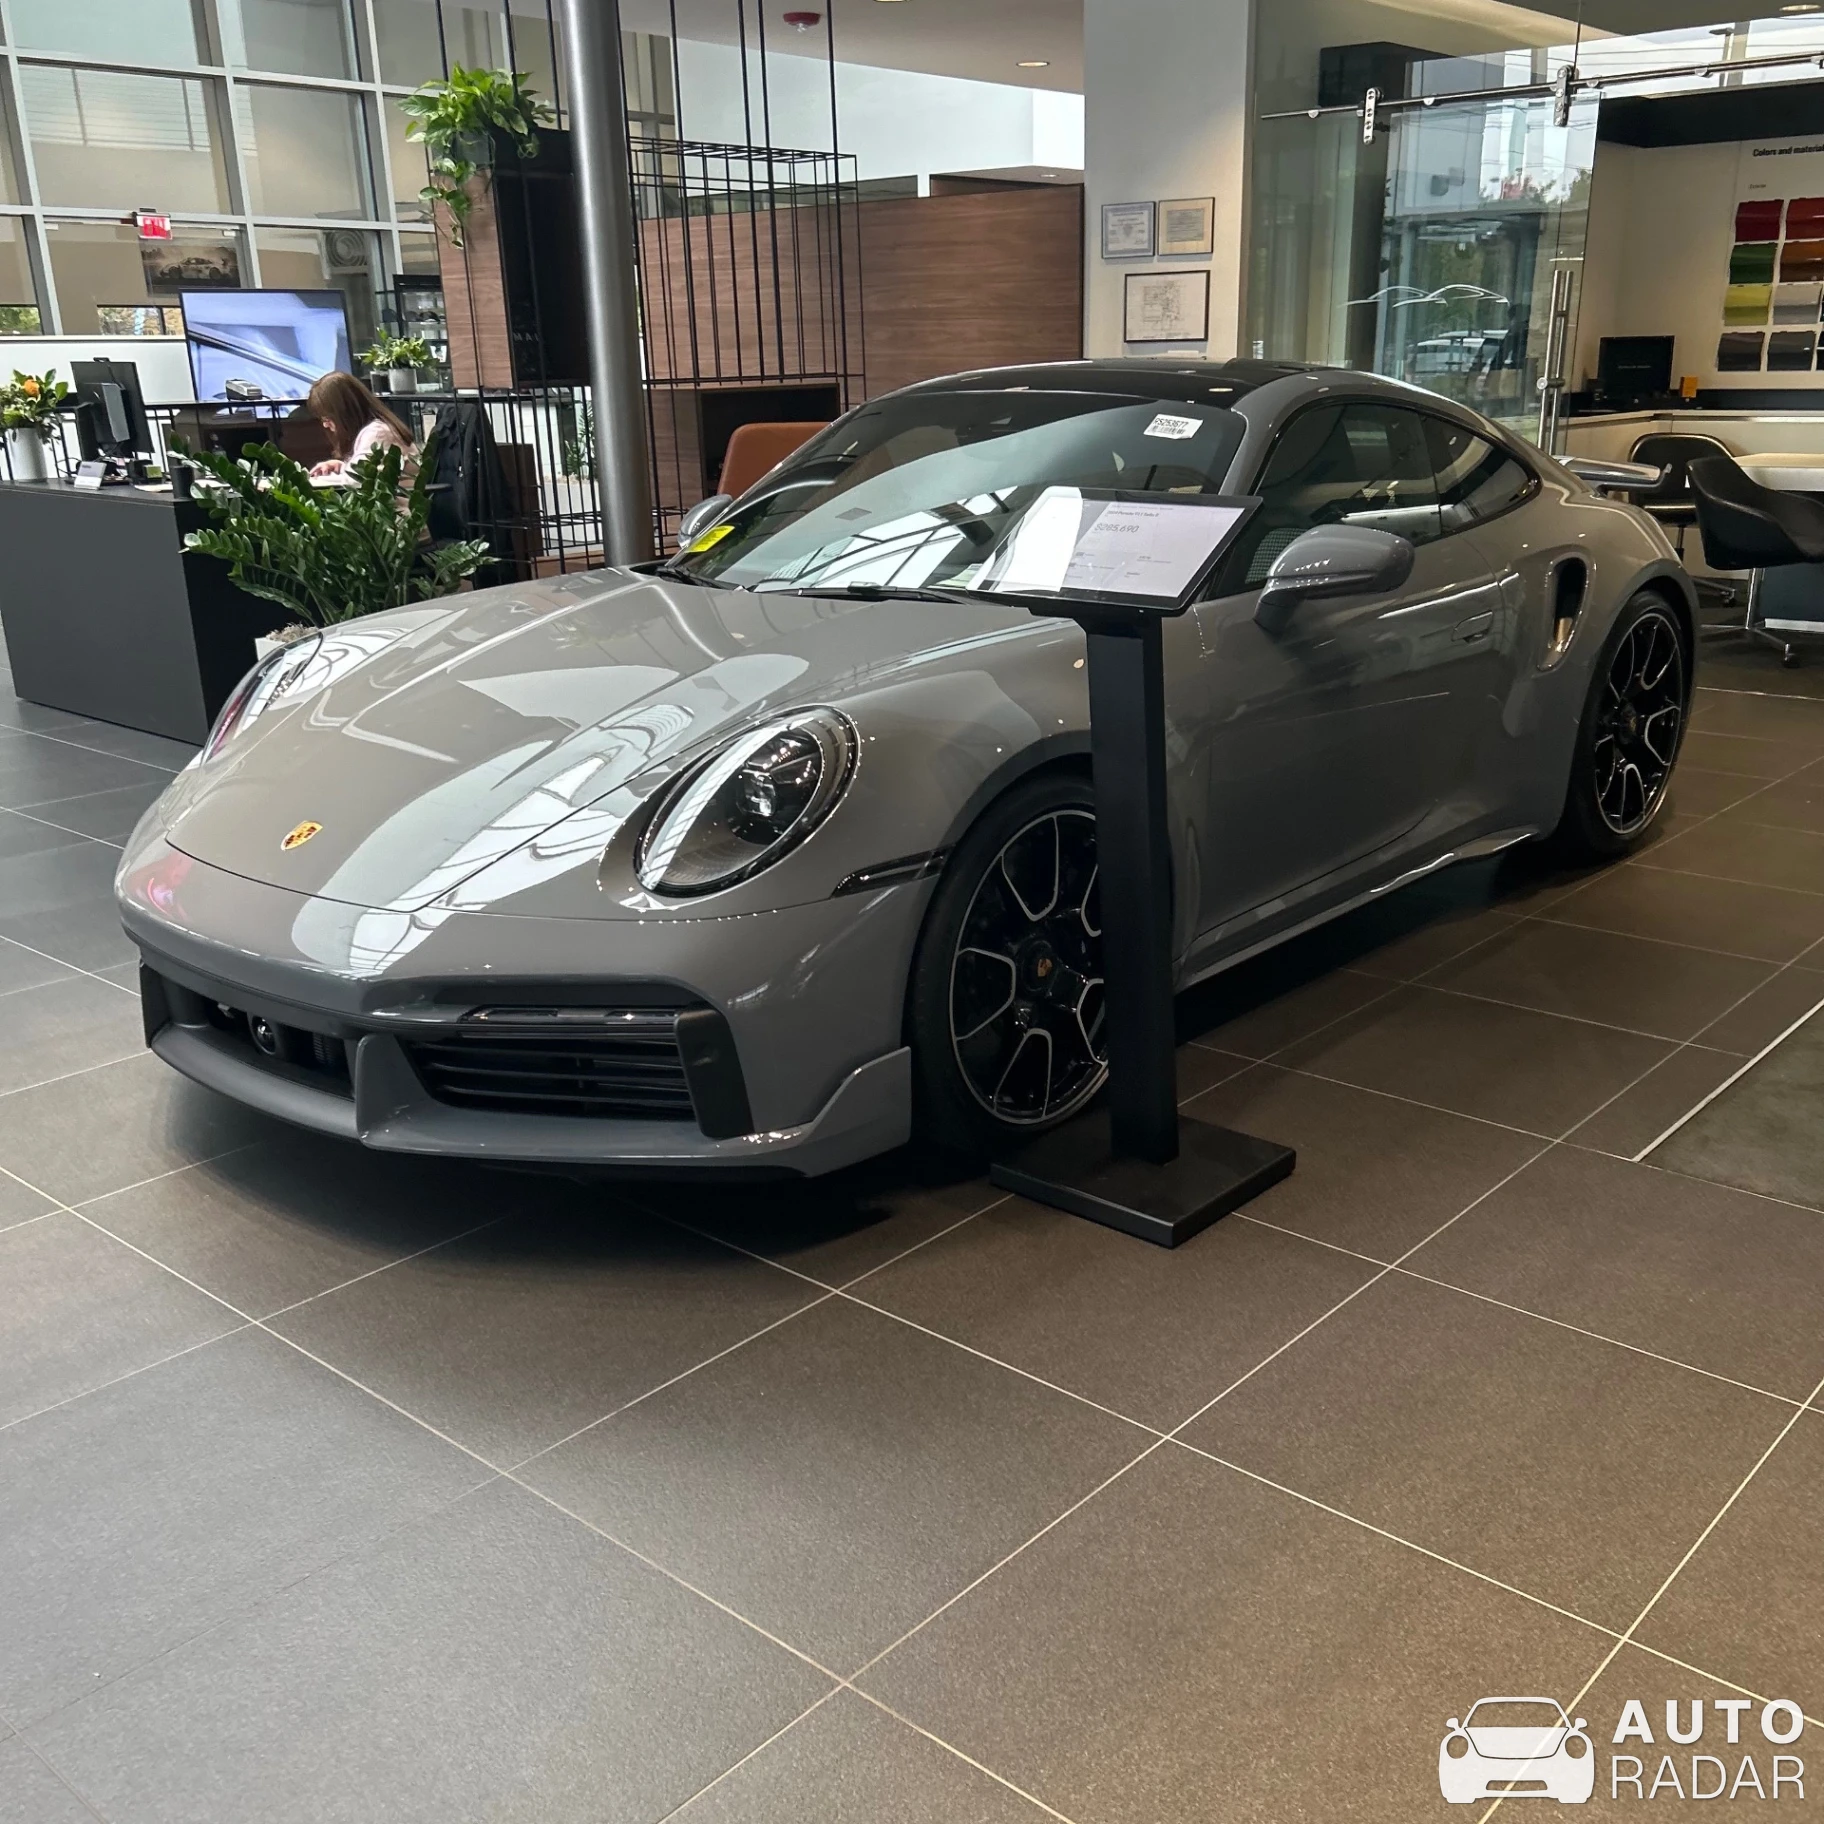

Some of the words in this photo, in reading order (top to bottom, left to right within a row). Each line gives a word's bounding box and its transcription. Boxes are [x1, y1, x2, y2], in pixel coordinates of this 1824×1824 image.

[1753, 148, 1777, 157] Colors
[1778, 146, 1793, 155] and
[143, 217, 166, 237] EXIT
[1094, 523, 1139, 533] $285,690
